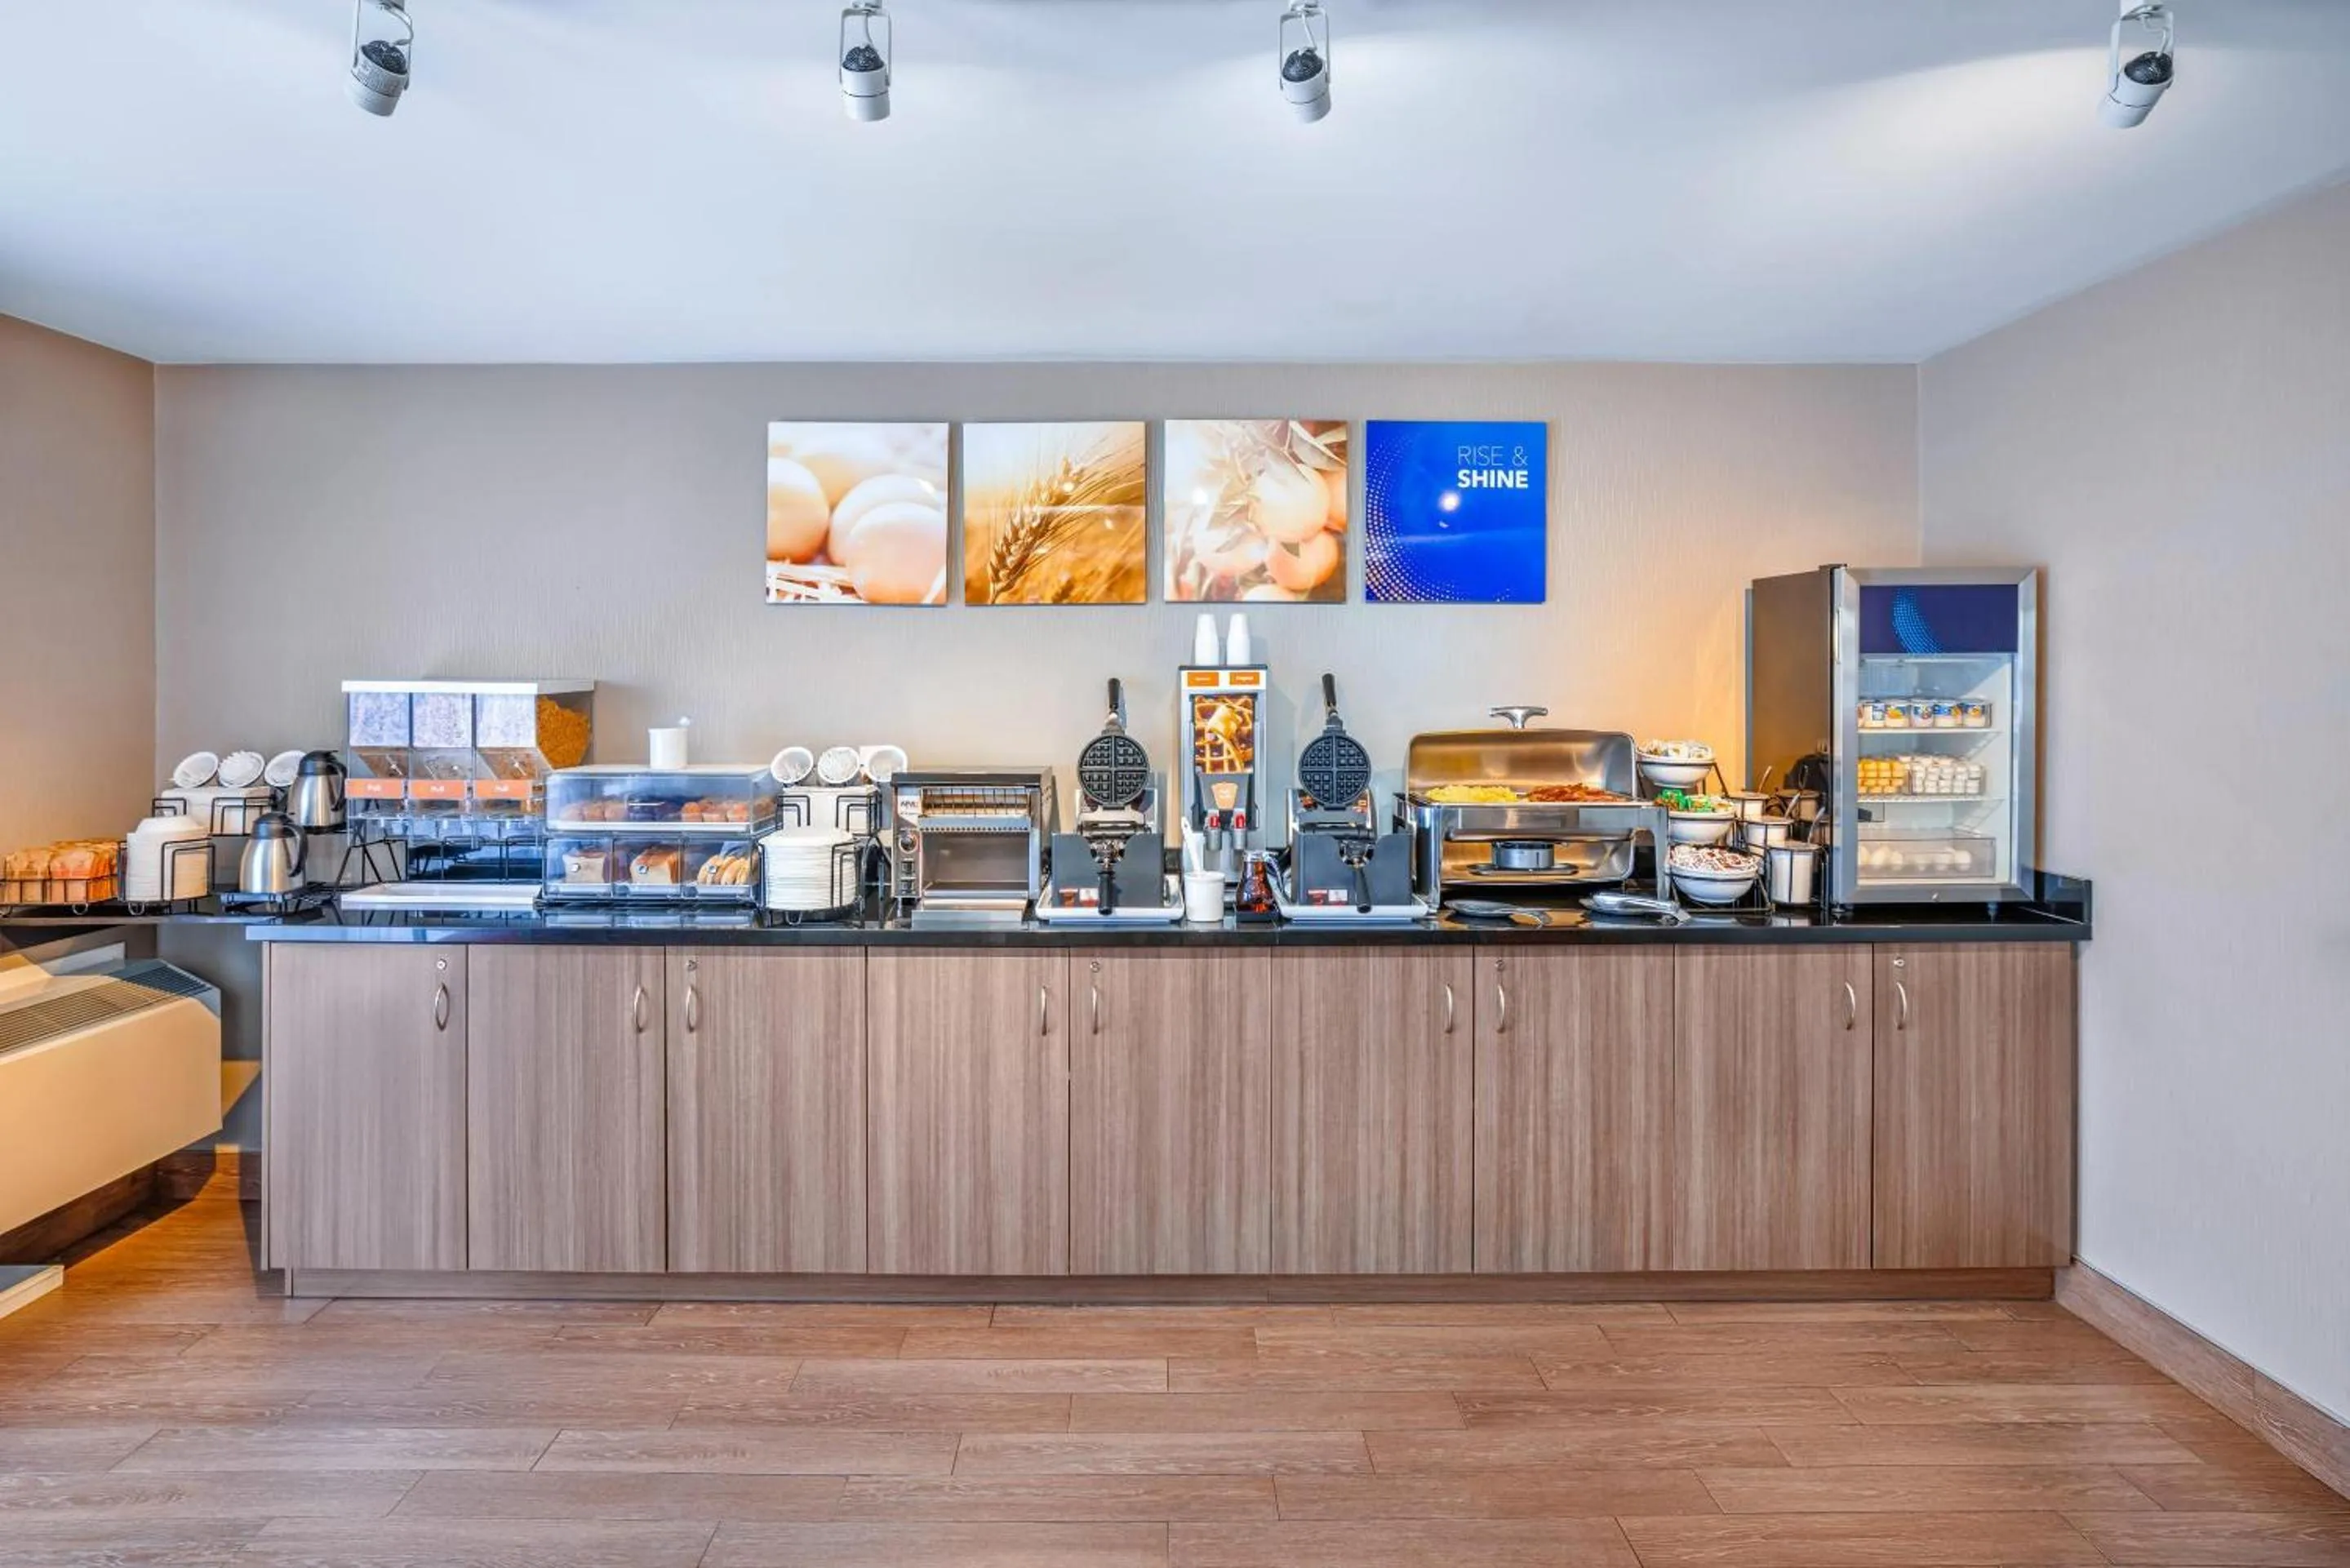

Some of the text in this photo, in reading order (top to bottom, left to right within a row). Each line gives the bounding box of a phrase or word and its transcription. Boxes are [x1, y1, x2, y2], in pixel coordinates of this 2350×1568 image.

[1458, 446, 1528, 467] RISE &
[1457, 469, 1529, 489] SHINE
